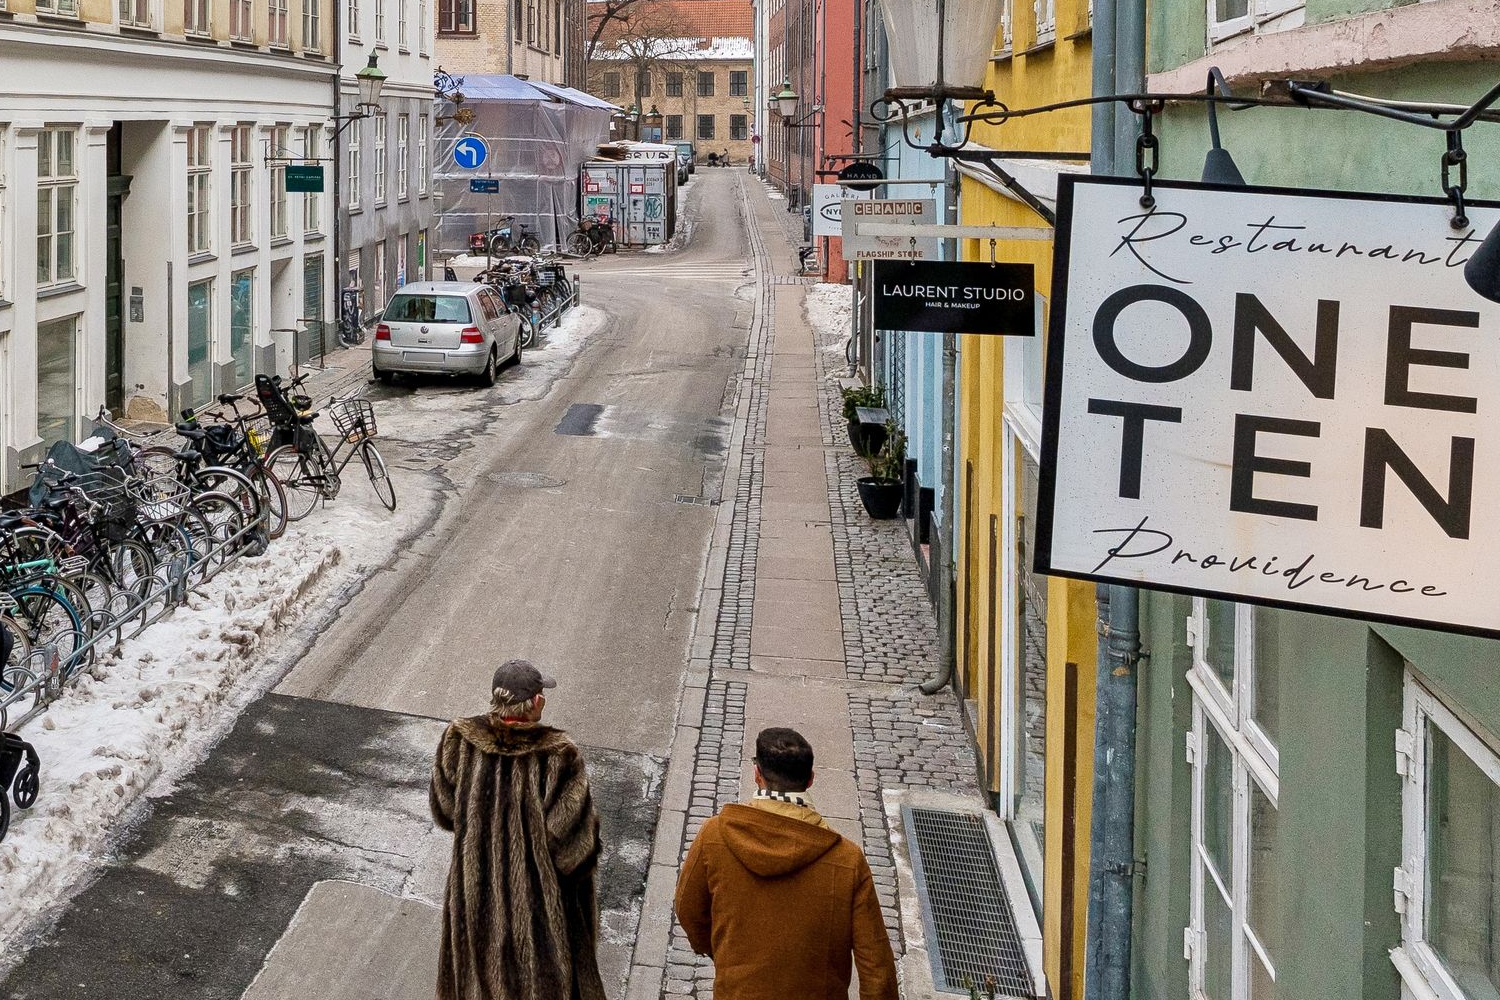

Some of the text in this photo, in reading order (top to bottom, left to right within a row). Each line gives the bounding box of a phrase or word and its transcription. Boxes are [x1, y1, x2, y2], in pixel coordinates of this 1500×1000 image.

[855, 202, 923, 216] CERAMIC
[1109, 205, 1488, 285] Restaurant
[856, 250, 923, 258] FLAGSHIP STORE
[883, 284, 1025, 301] LAURENT STUDIO
[1092, 284, 1481, 415] ONE
[1087, 398, 1476, 541] TEN
[1091, 516, 1449, 598] Providence
